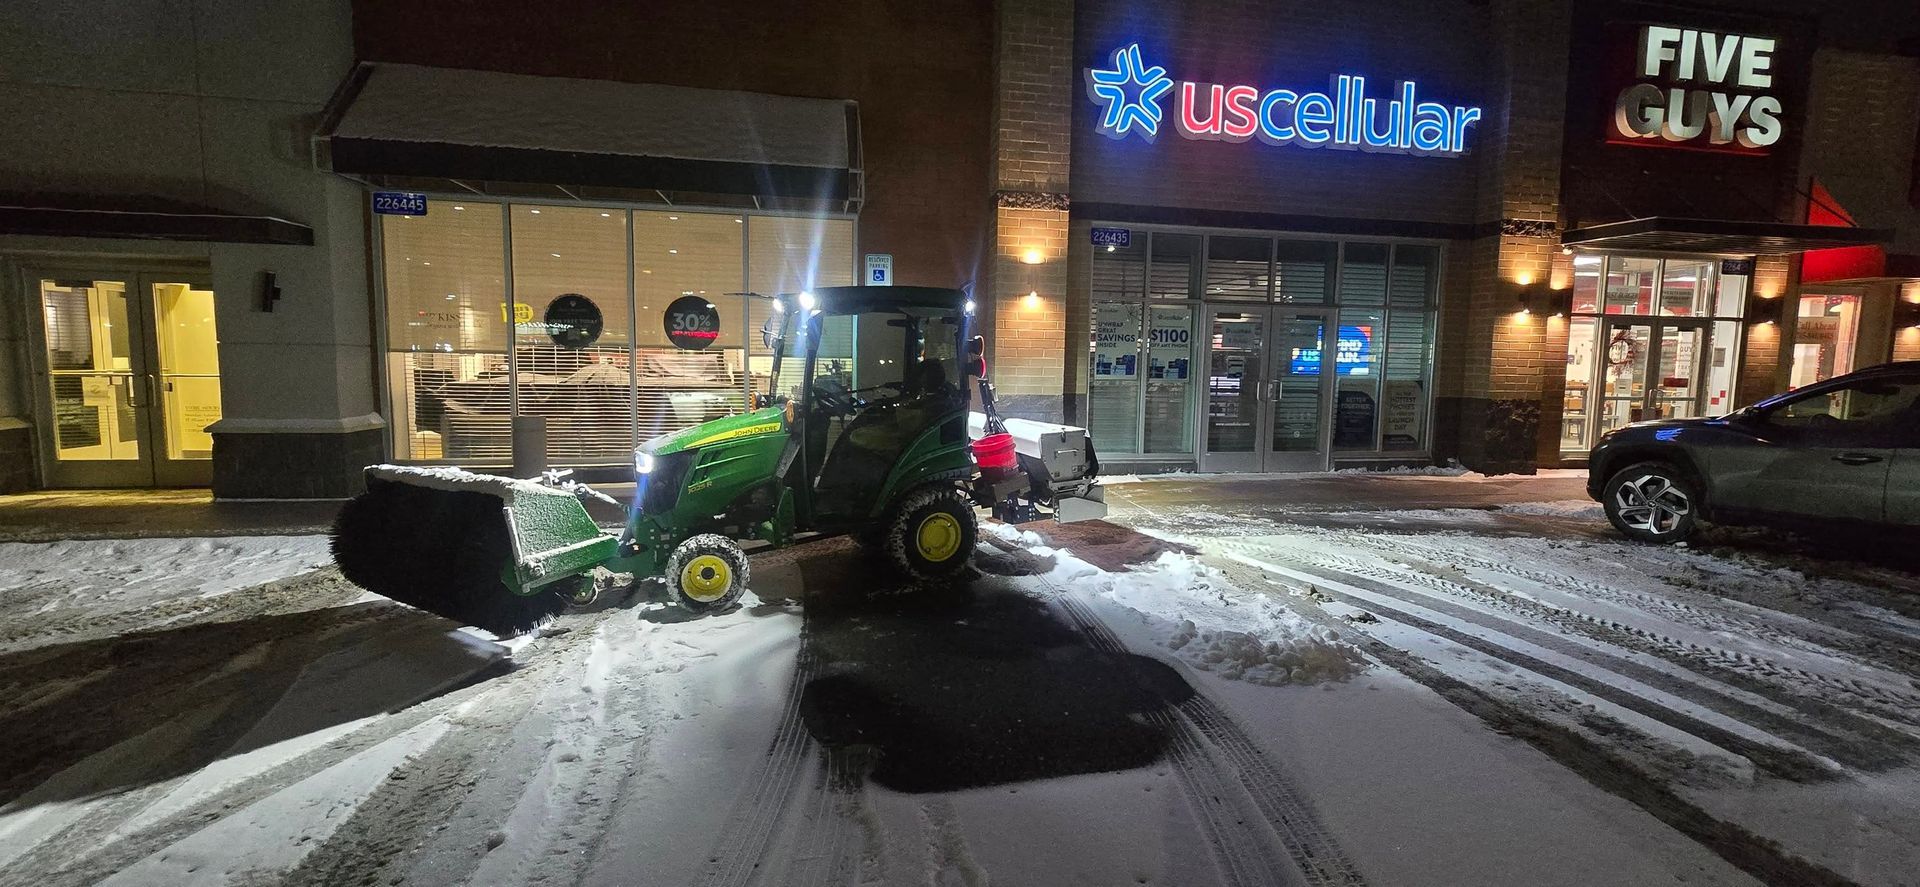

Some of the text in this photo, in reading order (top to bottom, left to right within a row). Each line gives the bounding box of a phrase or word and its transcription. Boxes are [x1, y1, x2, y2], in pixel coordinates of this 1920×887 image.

[1645, 26, 1775, 88] FIVE
[1180, 75, 1481, 152] uscellular
[1617, 83, 1782, 147] GUYS
[376, 197, 424, 211] 226445
[1093, 231, 1128, 243] 226435
[672, 312, 711, 331] 30%
[1097, 334, 1136, 343] SAVINGS
[1151, 328, 1189, 343] $1100
[733, 425, 777, 437] JOHN DEERE
